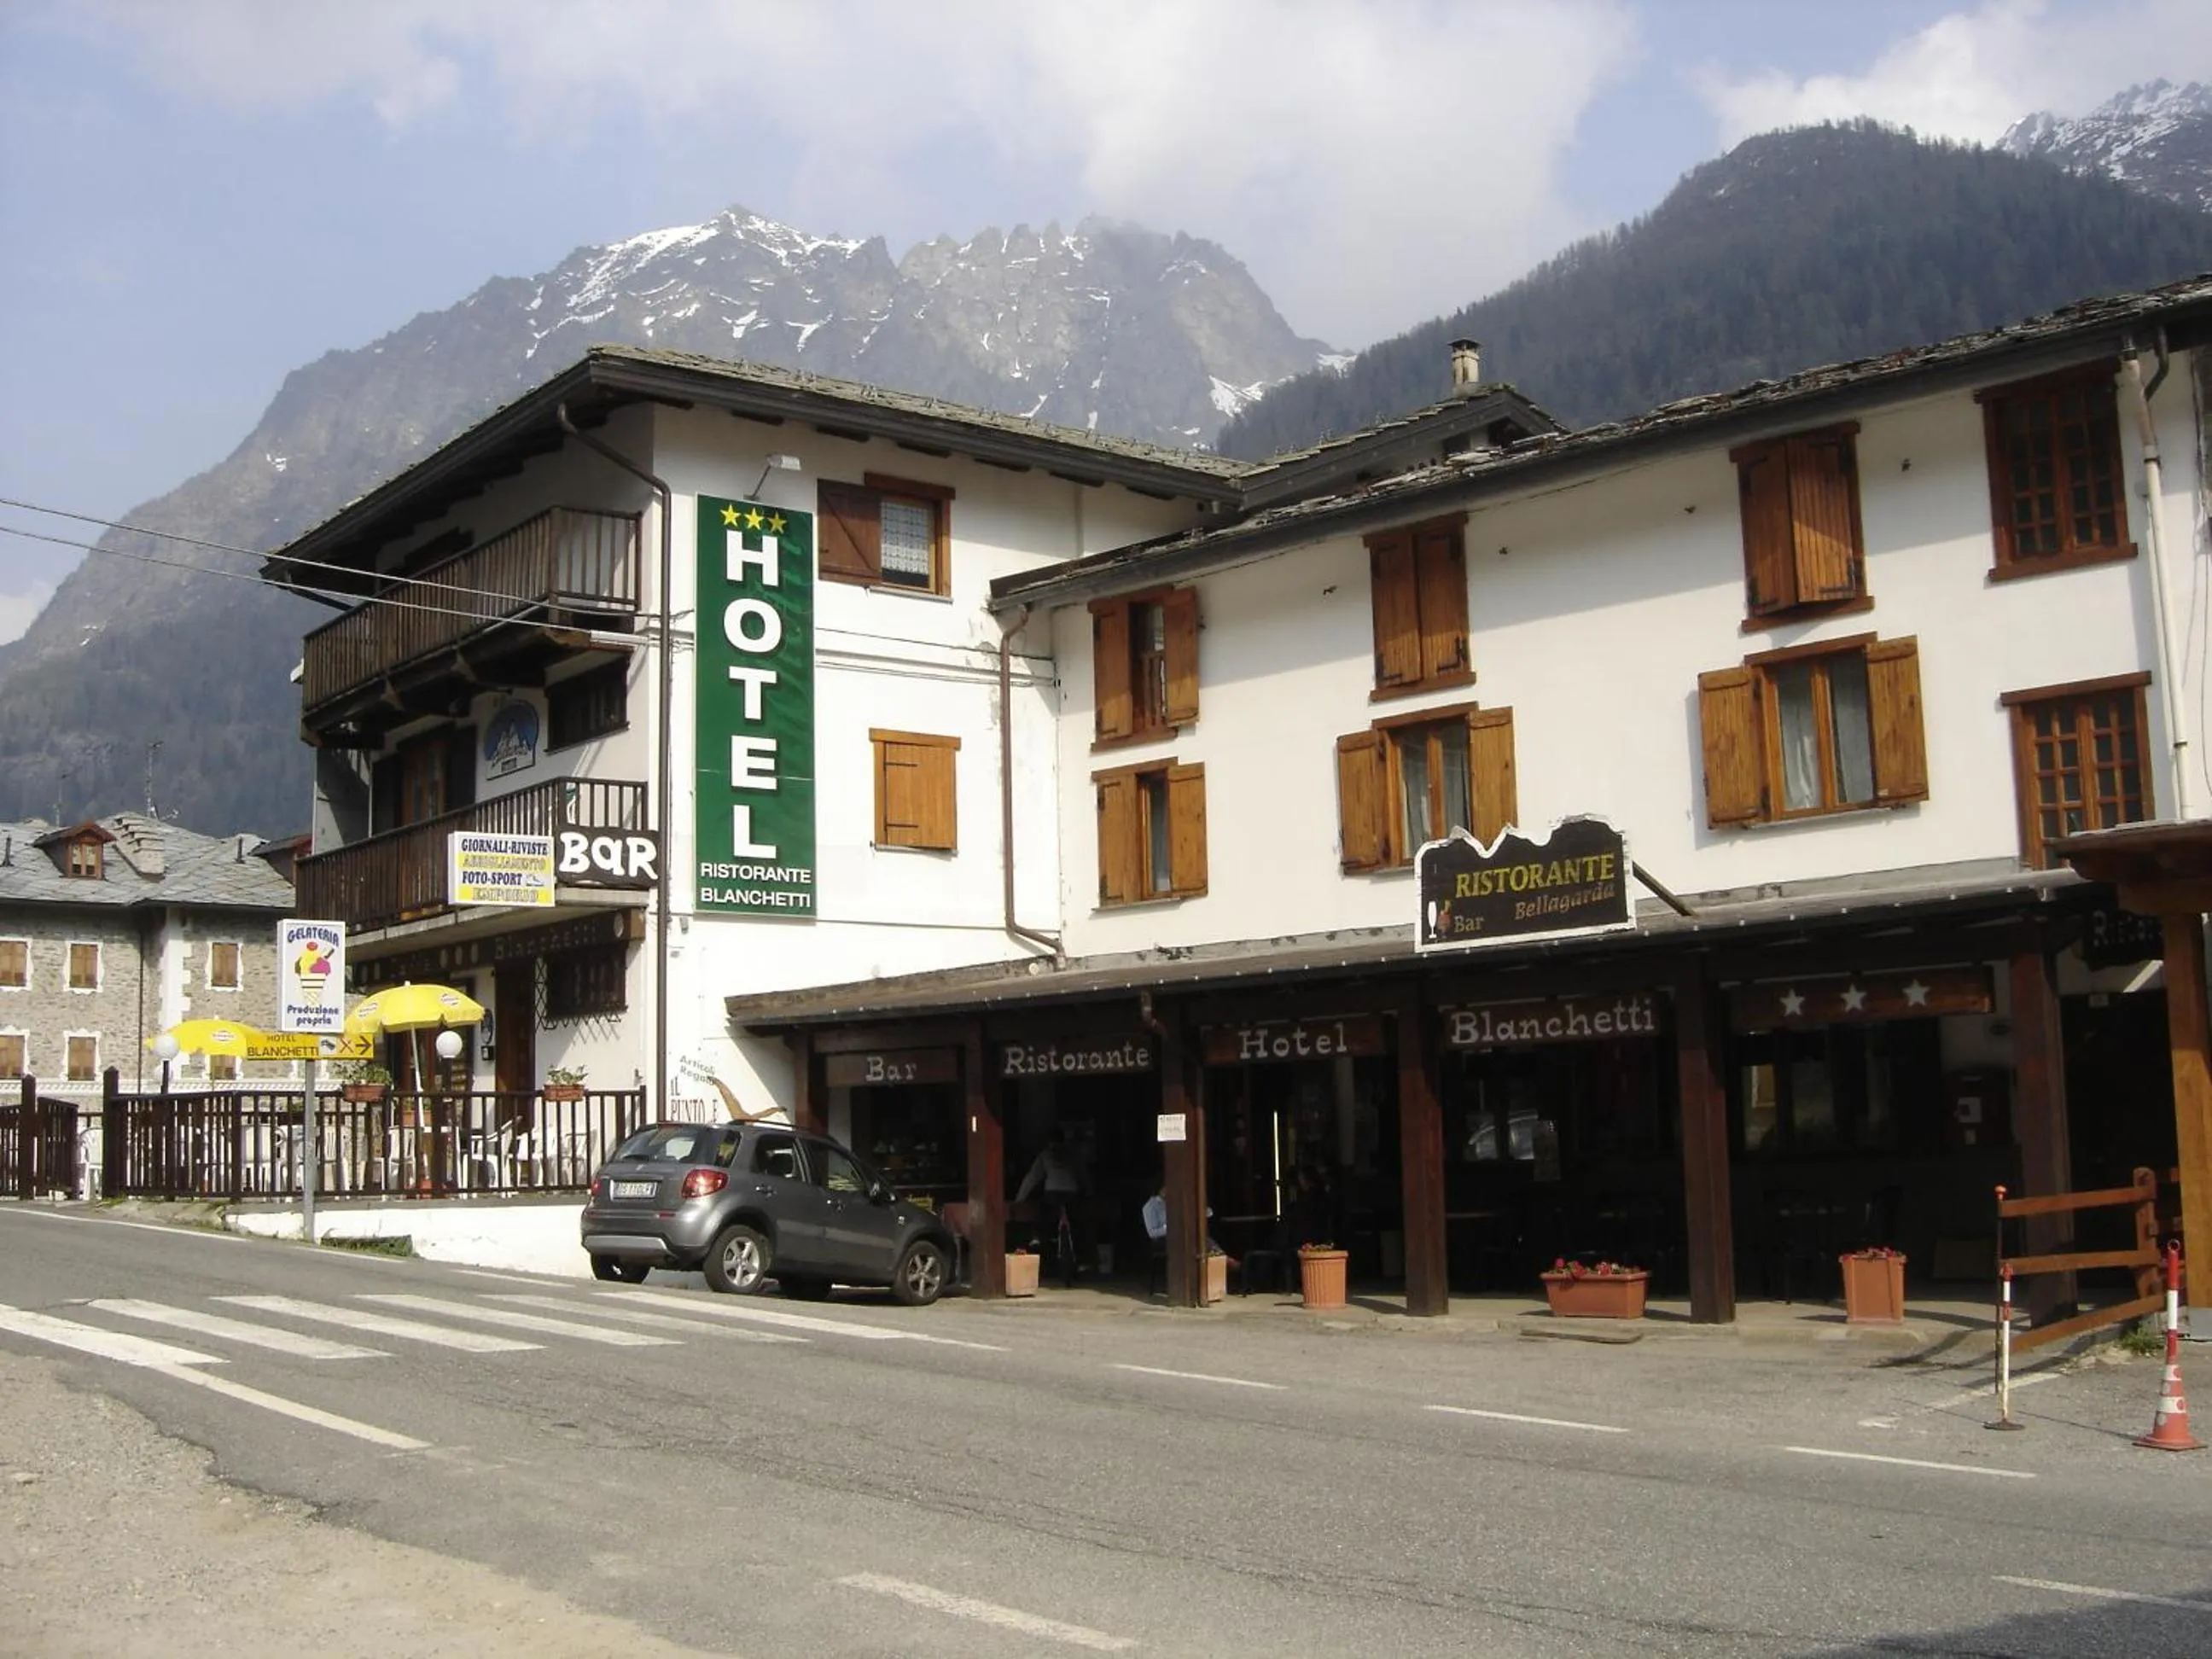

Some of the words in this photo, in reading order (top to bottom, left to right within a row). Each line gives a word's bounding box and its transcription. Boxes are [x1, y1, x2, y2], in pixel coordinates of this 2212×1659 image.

[725, 530, 782, 859] HOTEL
[462, 838, 548, 855] GIORNALI-RIVISTE
[462, 872, 523, 886] FOTO-SPORT
[701, 862, 812, 884] RISTORANTE
[1455, 853, 1615, 899] RISTORANTE
[701, 888, 811, 909] BLANCHETTI
[1514, 882, 1615, 921] Bellagarda
[1453, 915, 1485, 934] Bar
[287, 927, 340, 947] GELATERIA
[287, 1004, 340, 1015] Produzione
[296, 1016, 332, 1027] propria
[1452, 998, 1656, 1045] Blanchetti
[247, 1046, 319, 1057] BLANCHETTI
[1237, 1023, 1348, 1060] Hotel
[1004, 1041, 1150, 1075] Ristorante
[865, 1056, 917, 1082] Bar
[671, 1076, 681, 1096] IL
